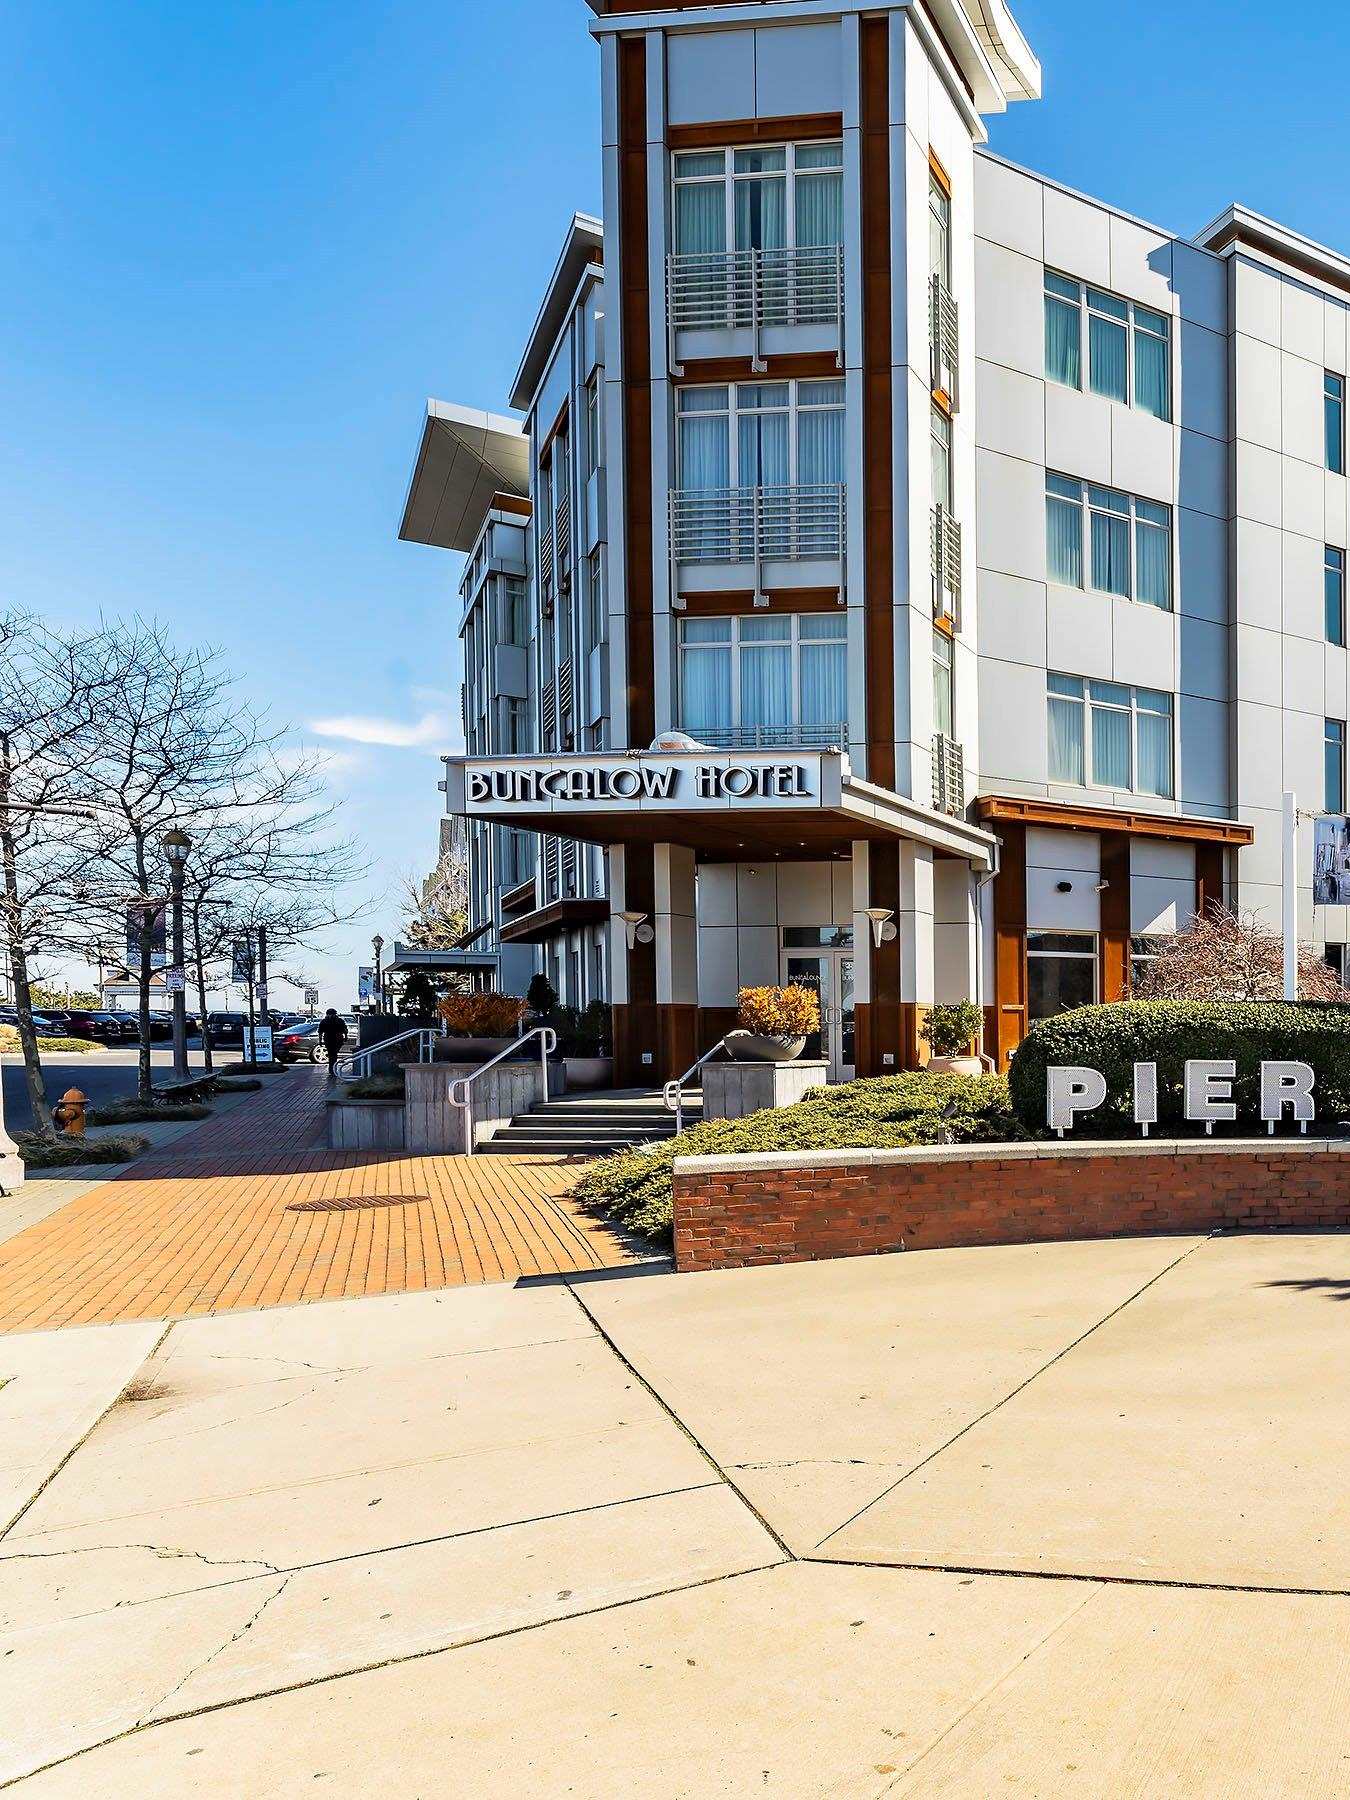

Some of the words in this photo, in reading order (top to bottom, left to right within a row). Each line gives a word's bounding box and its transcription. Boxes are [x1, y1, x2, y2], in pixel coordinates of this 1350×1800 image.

[466, 766, 679, 801] BUNGALOW
[695, 765, 809, 797] HOTEL
[1046, 1059, 1317, 1130] PIER
